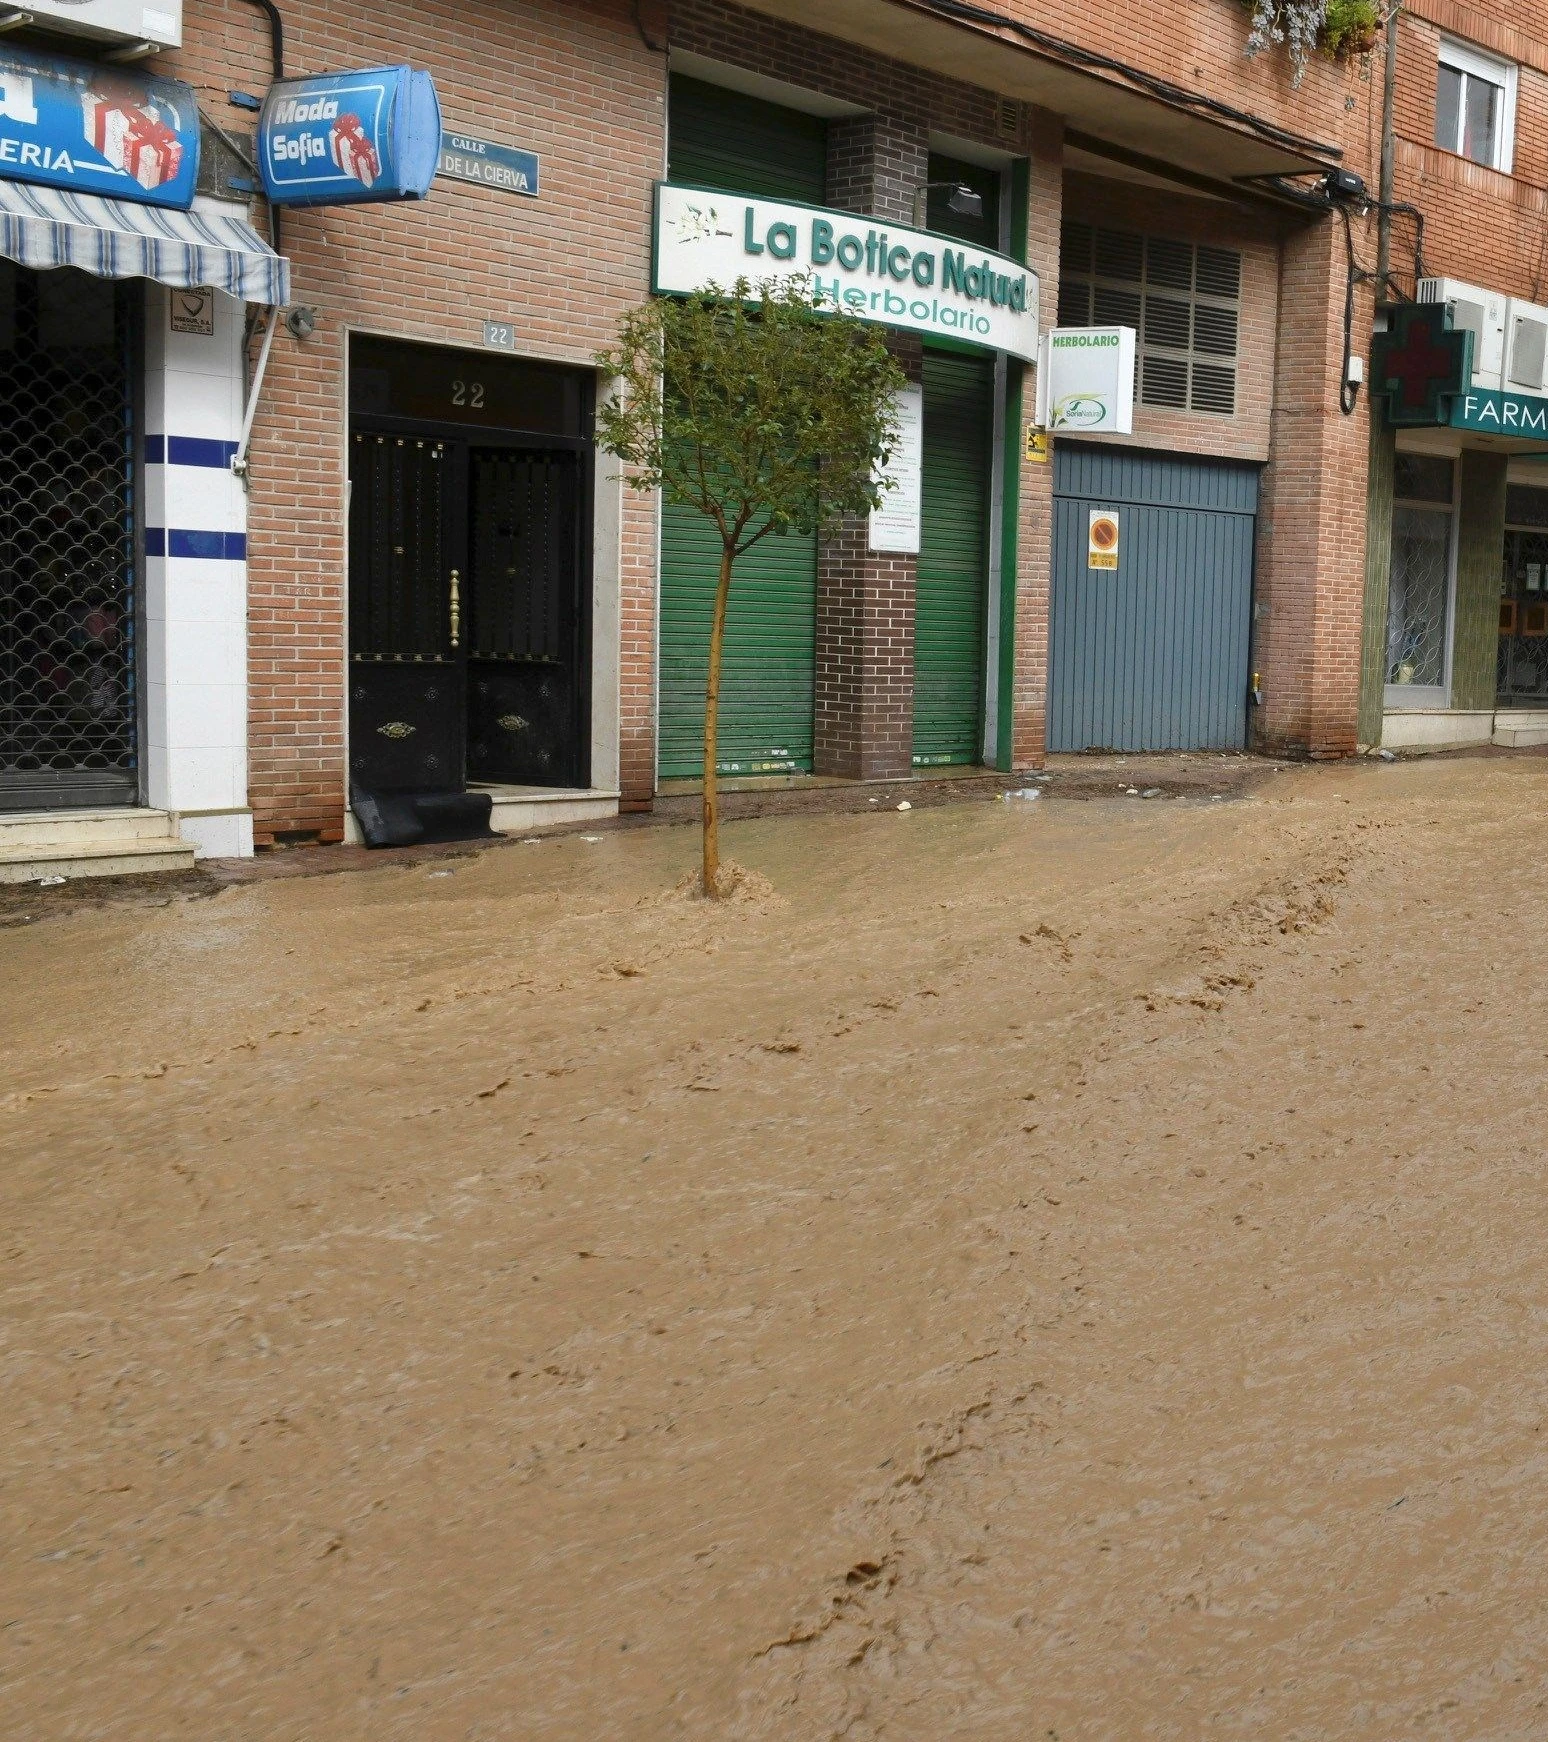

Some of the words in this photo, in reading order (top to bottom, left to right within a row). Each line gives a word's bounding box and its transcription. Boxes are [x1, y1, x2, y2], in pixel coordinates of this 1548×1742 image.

[275, 97, 338, 124] Moda
[274, 133, 326, 165] Sofia
[452, 138, 486, 154] CALLE
[445, 155, 462, 173] DE
[466, 160, 481, 178] LA
[484, 165, 528, 189] CIERVA
[745, 207, 797, 258] La
[812, 218, 935, 285] Botica
[942, 248, 1028, 313] Natural
[813, 276, 991, 335] Herbolario
[491, 327, 507, 344] 22
[1053, 336, 1119, 347] HERBOLARIO
[452, 380, 484, 408] 22
